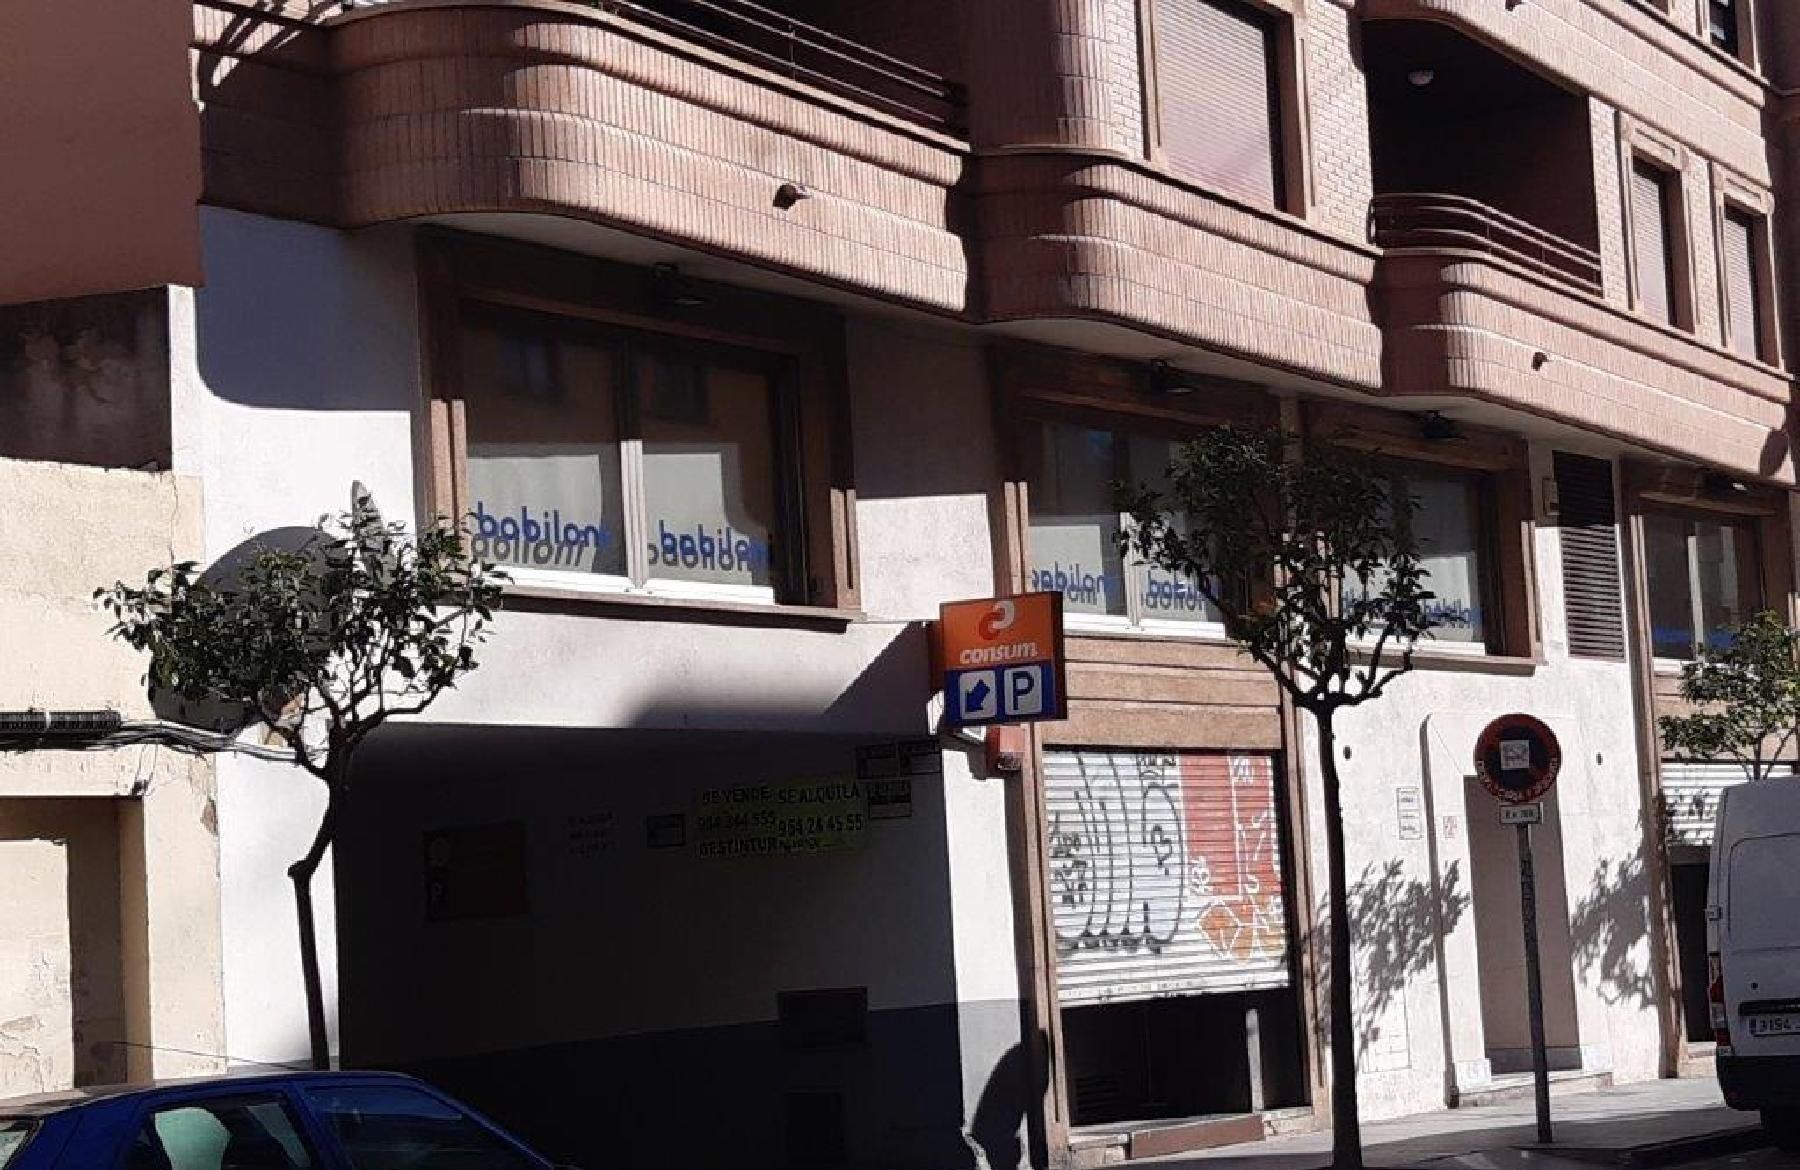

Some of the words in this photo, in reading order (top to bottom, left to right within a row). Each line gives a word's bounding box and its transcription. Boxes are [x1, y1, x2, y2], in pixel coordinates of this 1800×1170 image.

[960, 643, 1039, 664] consum
[1013, 670, 1034, 710] P
[779, 787, 796, 804] SE
[800, 781, 860, 804] ALQUILA
[846, 813, 862, 831] 55
